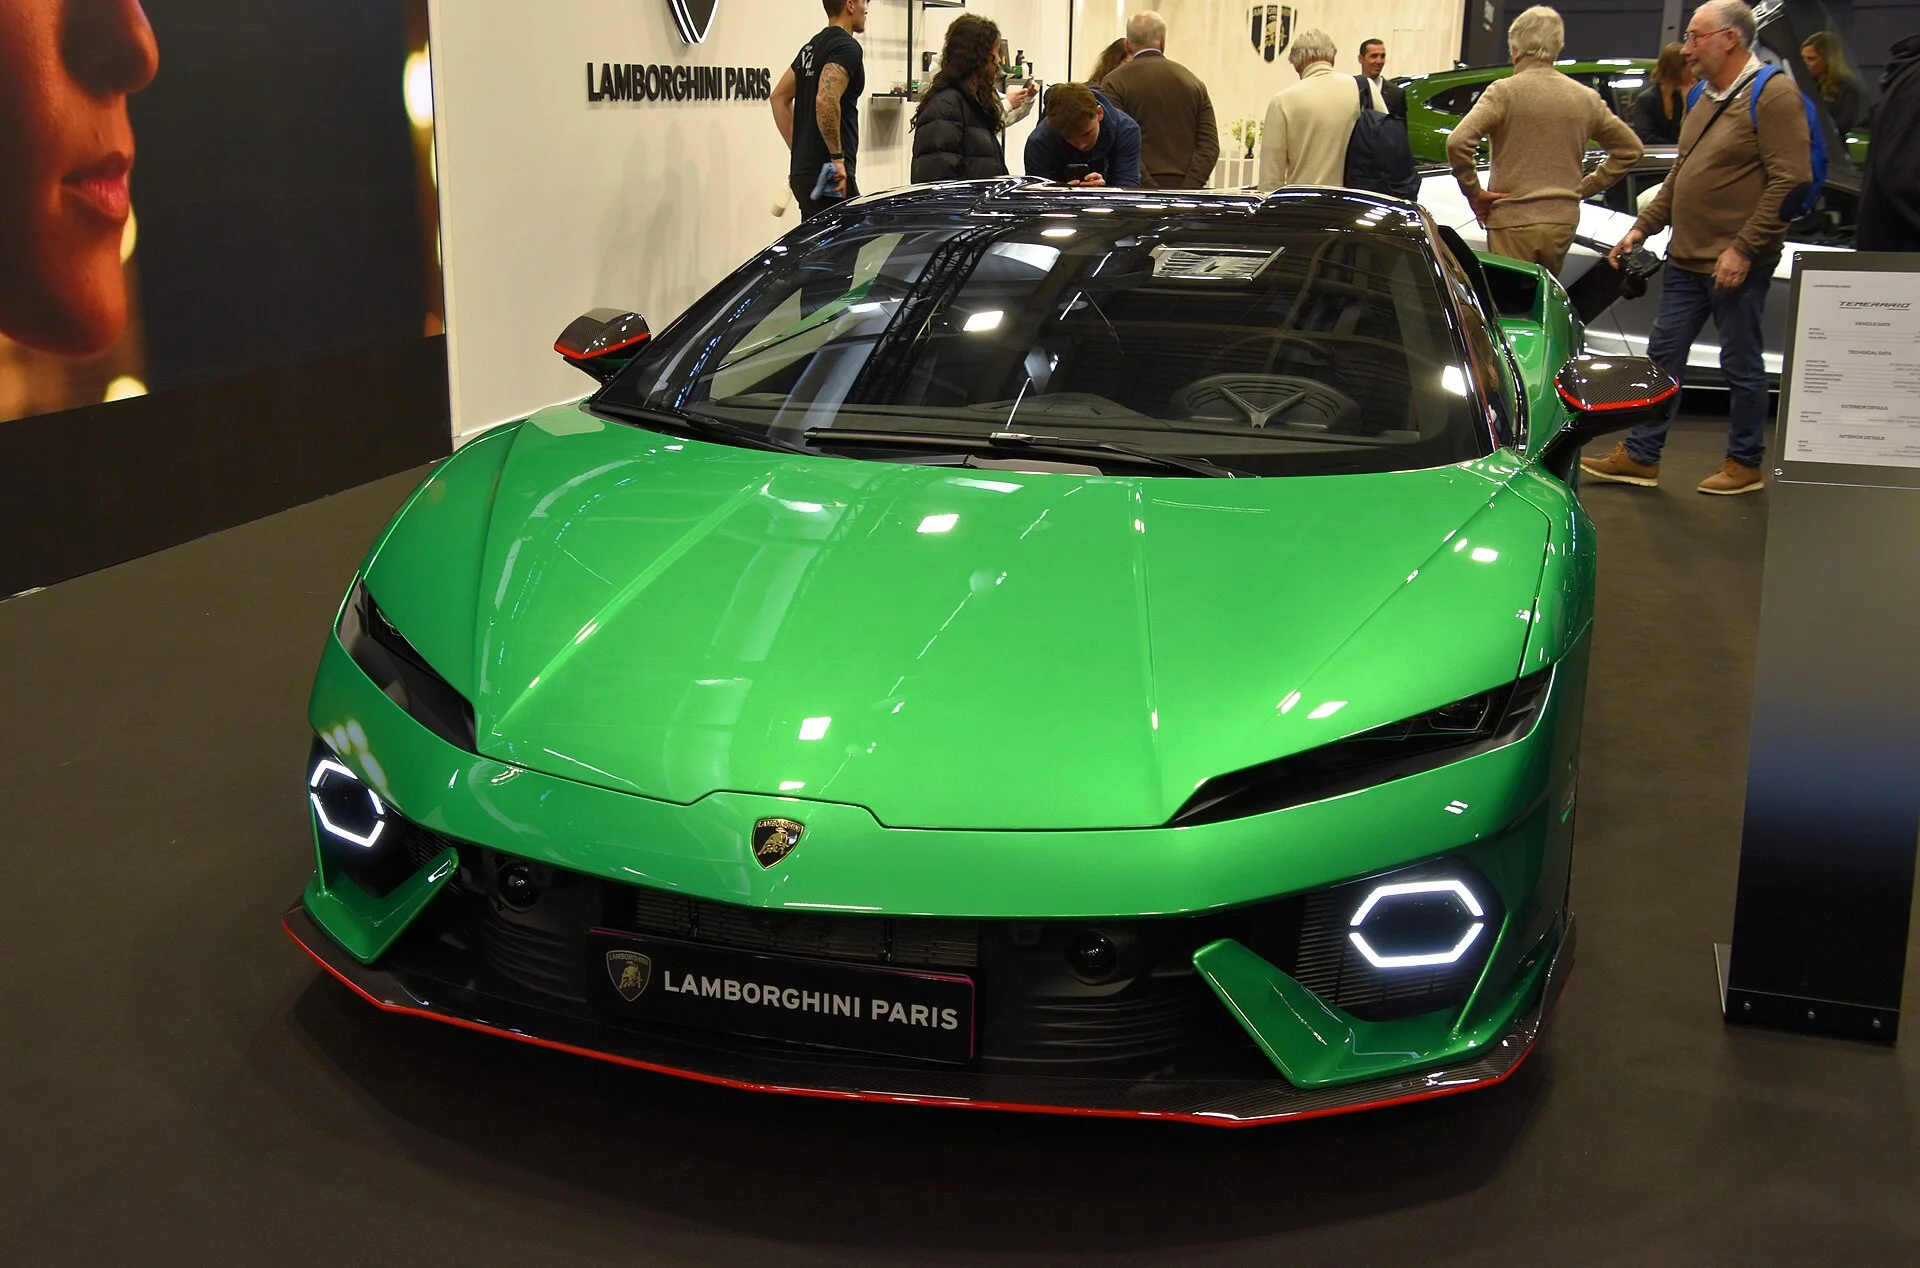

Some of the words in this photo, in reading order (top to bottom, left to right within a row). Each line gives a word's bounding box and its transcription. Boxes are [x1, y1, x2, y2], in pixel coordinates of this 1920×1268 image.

[587, 62, 723, 101] LAMBORGHINI
[725, 67, 771, 101] PARIS
[758, 819, 802, 832] LAMBORGHINI
[664, 970, 860, 1018] LAMBORGHINI
[872, 1000, 958, 1030] PARIS
